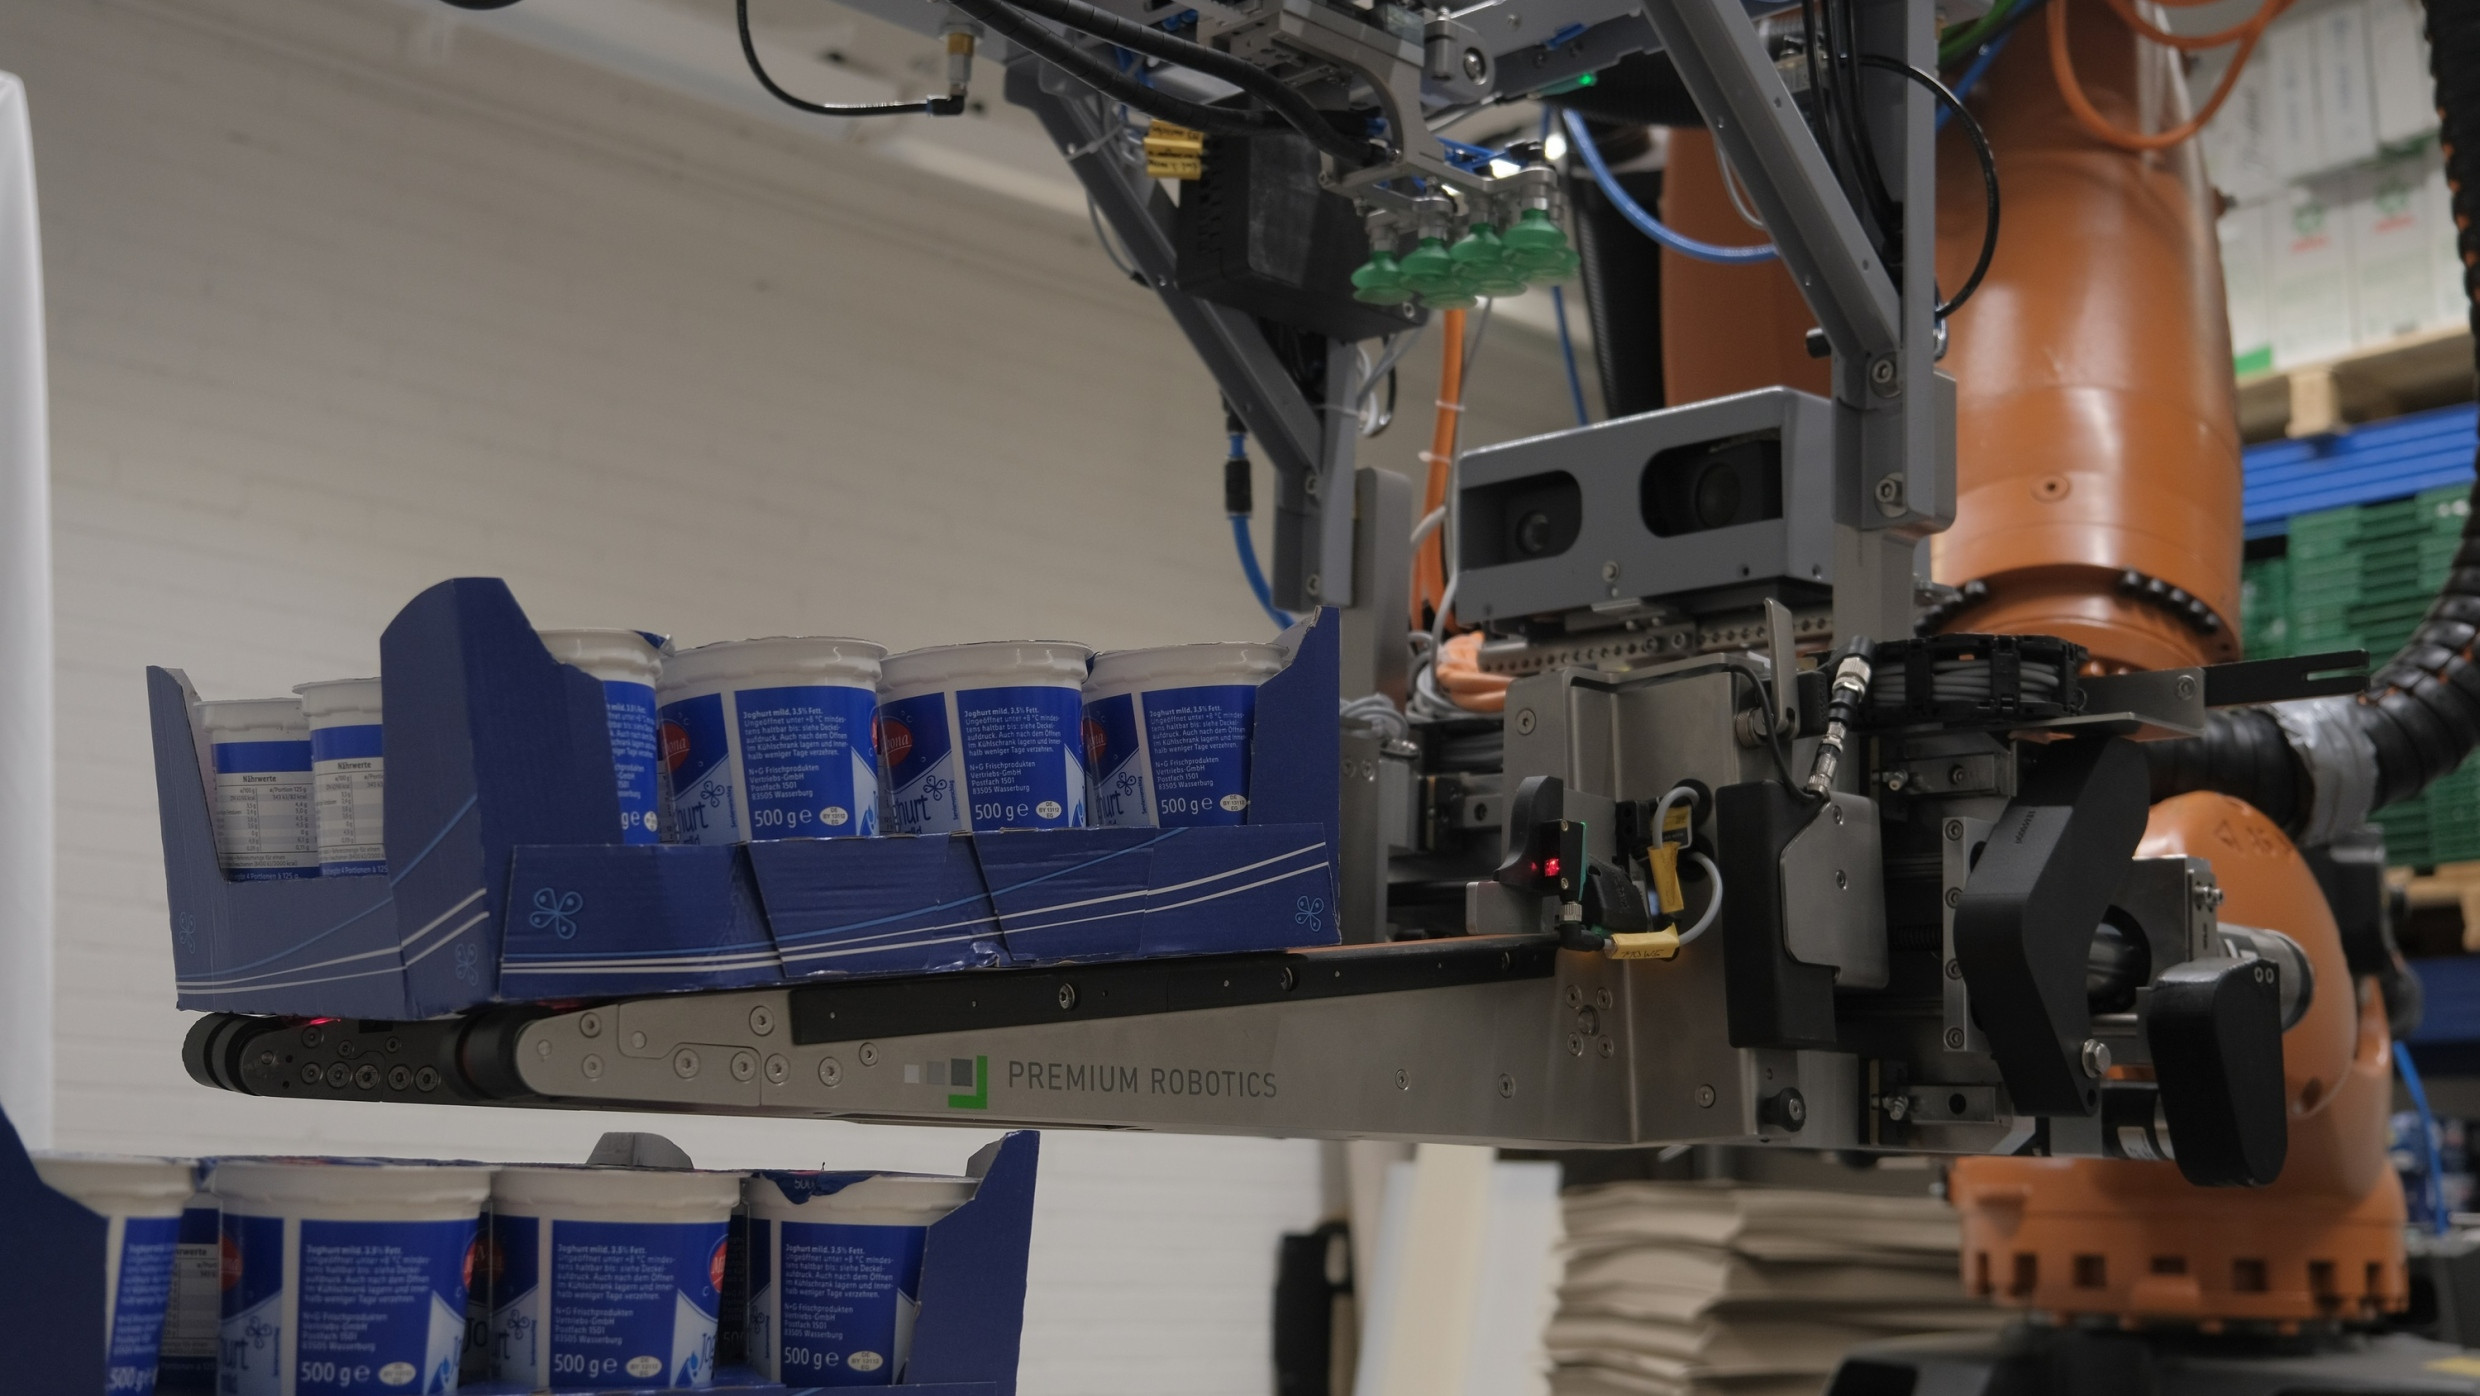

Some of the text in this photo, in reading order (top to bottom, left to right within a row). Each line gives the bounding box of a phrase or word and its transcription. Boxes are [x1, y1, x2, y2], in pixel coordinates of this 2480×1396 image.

[965, 710, 991, 718] Joghurt
[1011, 747, 1025, 755] Tage
[994, 785, 1030, 793] Wasserburg
[975, 803, 1002, 820] 500
[1006, 806, 1014, 821] g
[1161, 798, 1186, 814] 500
[1190, 800, 1199, 815] g
[621, 812, 629, 830] g
[755, 809, 783, 827] 500
[1009, 1061, 1277, 1099] PREMIUM ROBOTICS
[784, 1347, 810, 1365] 500
[302, 1362, 335, 1382] 500
[340, 1367, 351, 1387] g
[555, 1354, 585, 1373] 500
[589, 1359, 599, 1378] g
